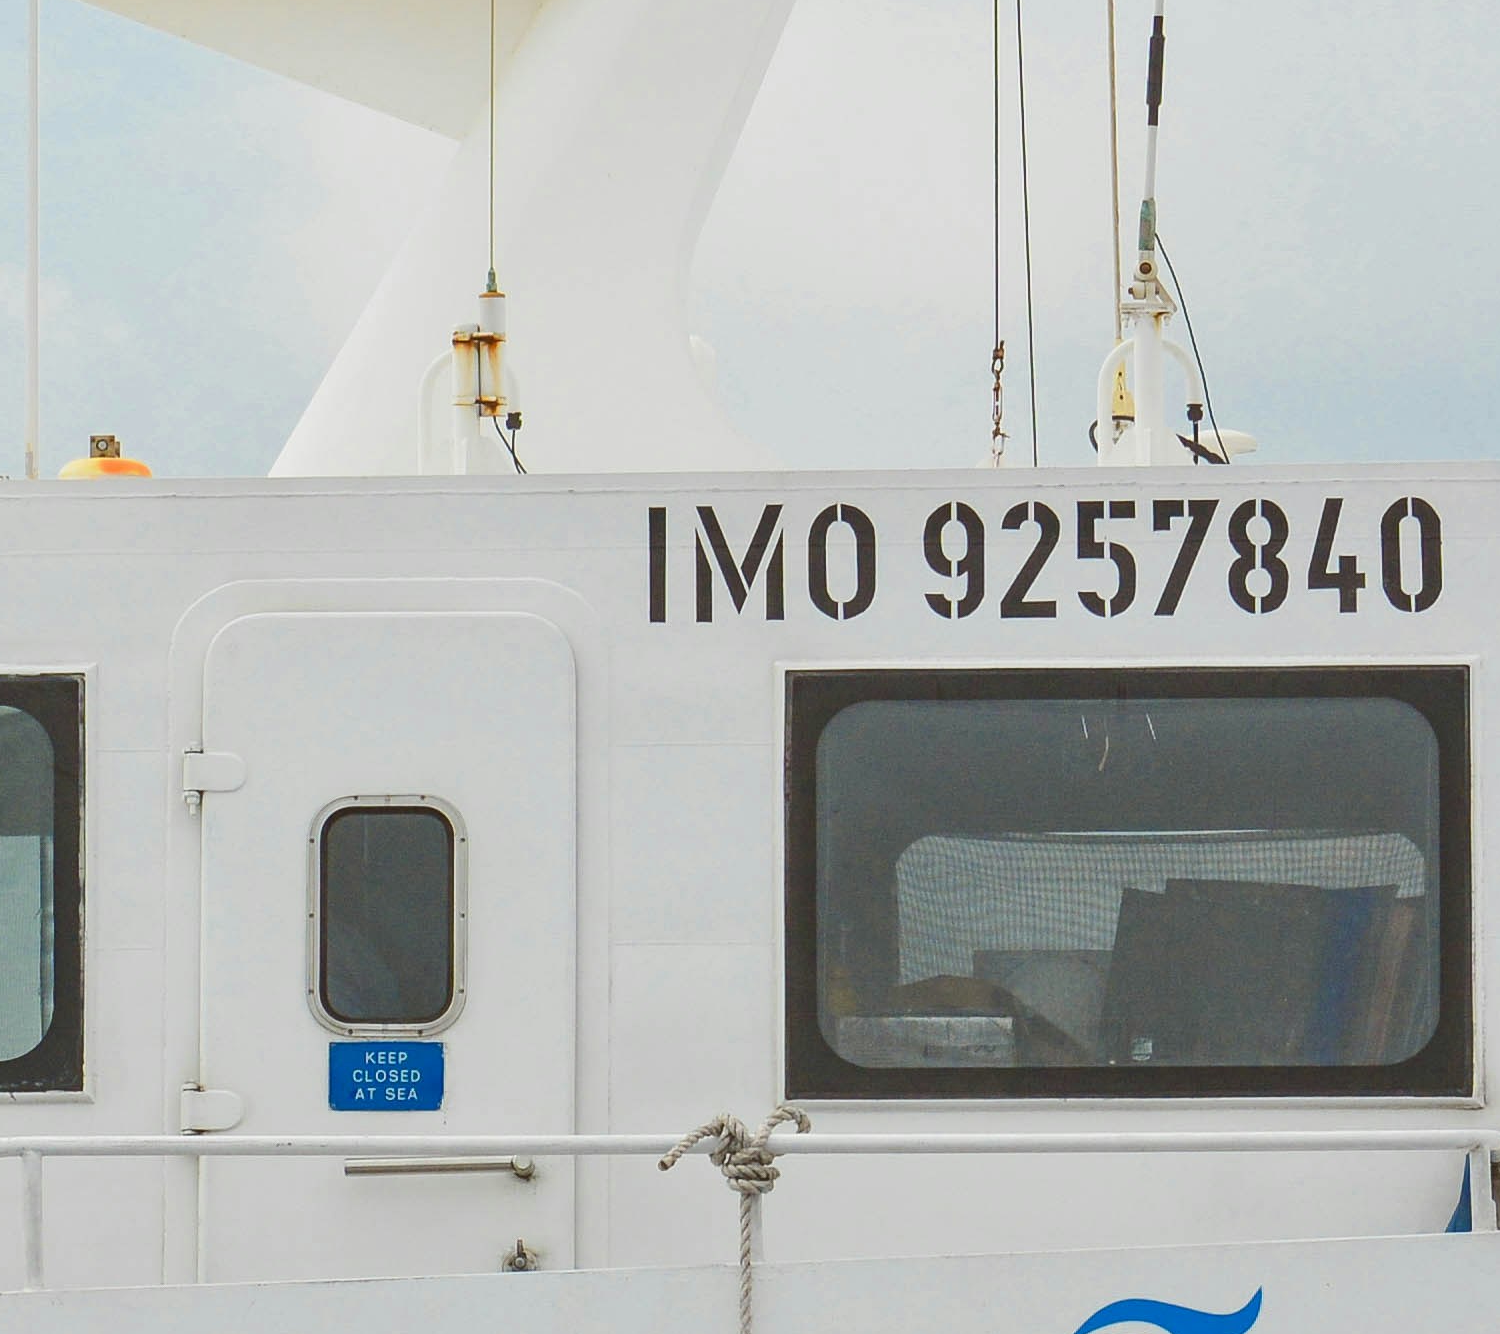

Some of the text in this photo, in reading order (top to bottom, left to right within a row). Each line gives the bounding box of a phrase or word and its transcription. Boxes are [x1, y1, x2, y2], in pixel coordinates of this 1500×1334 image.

[649, 496, 1443, 623] IMO 9257840
[365, 1051, 408, 1065] KEEP
[352, 1069, 421, 1083] CLOSED
[355, 1087, 418, 1101] AT SEA
